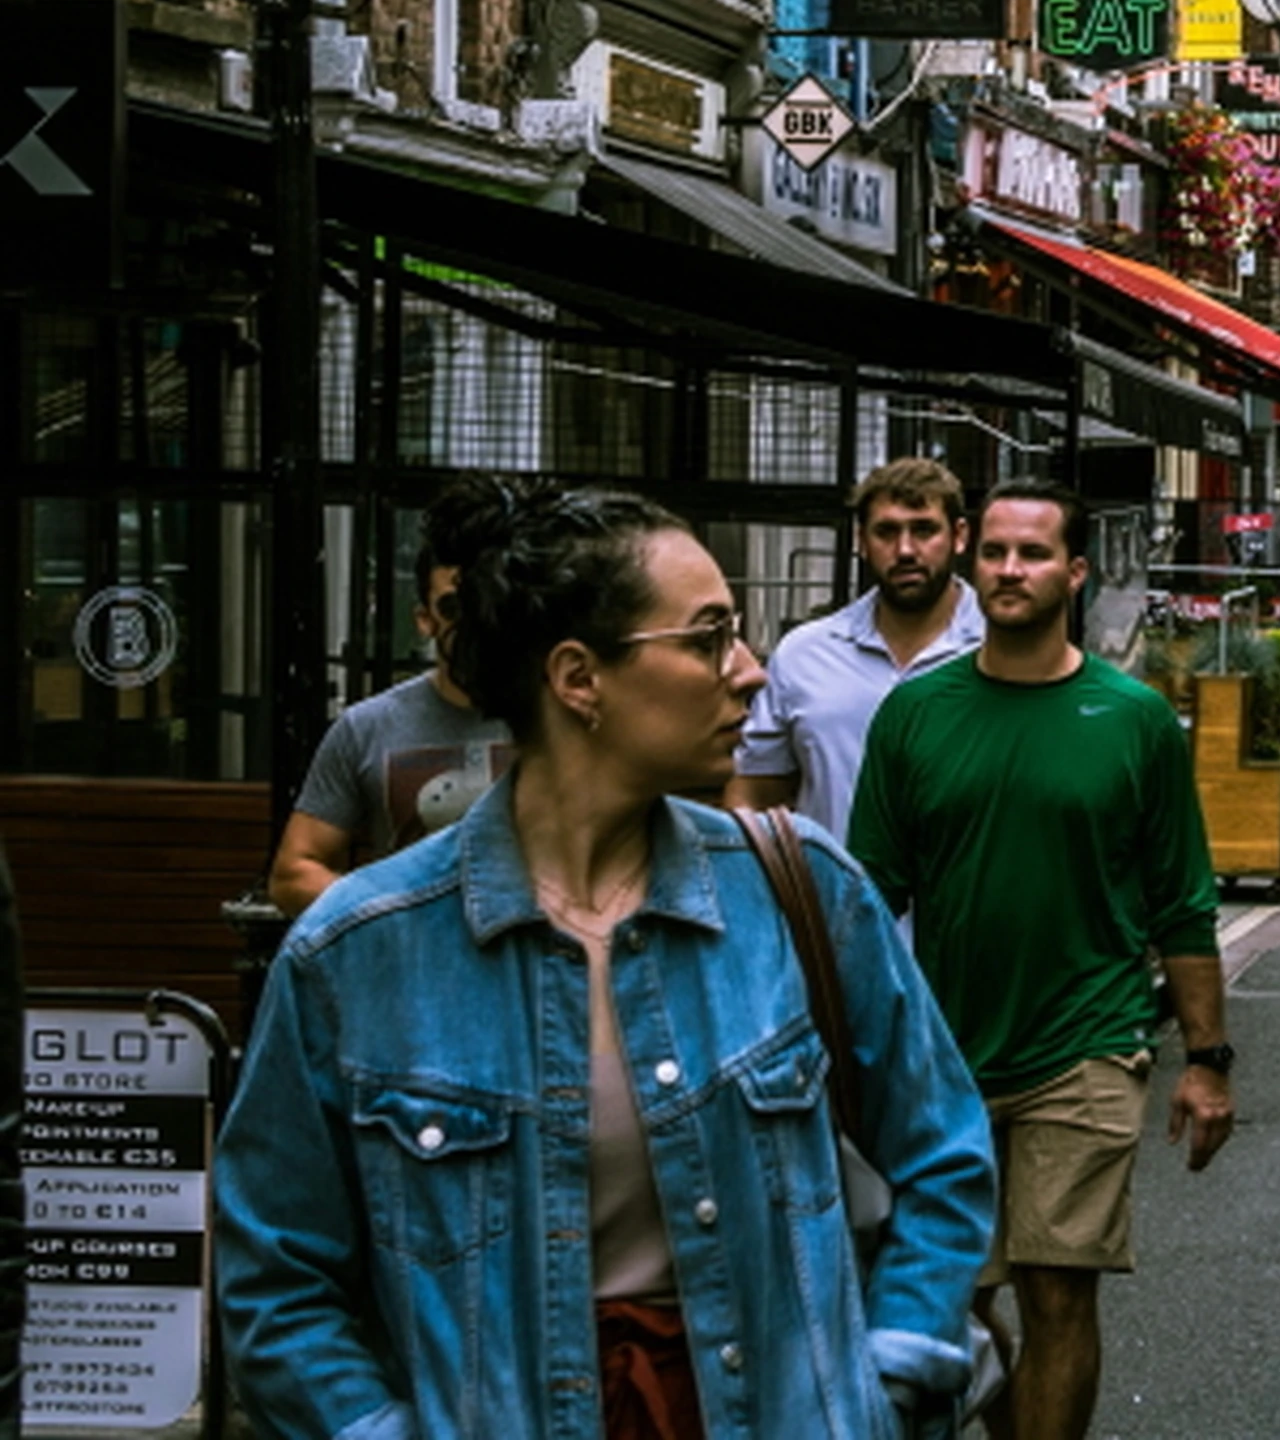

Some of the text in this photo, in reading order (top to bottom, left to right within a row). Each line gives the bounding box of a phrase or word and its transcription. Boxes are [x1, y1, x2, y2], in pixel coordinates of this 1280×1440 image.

[783, 110, 834, 135] GBK
[30, 1029, 188, 1063] GLOT
[63, 1072, 150, 1091] STORE
[35, 1178, 181, 1196] APPLICATION
[94, 1203, 147, 1220] €14
[71, 1240, 177, 1257] COURSES
